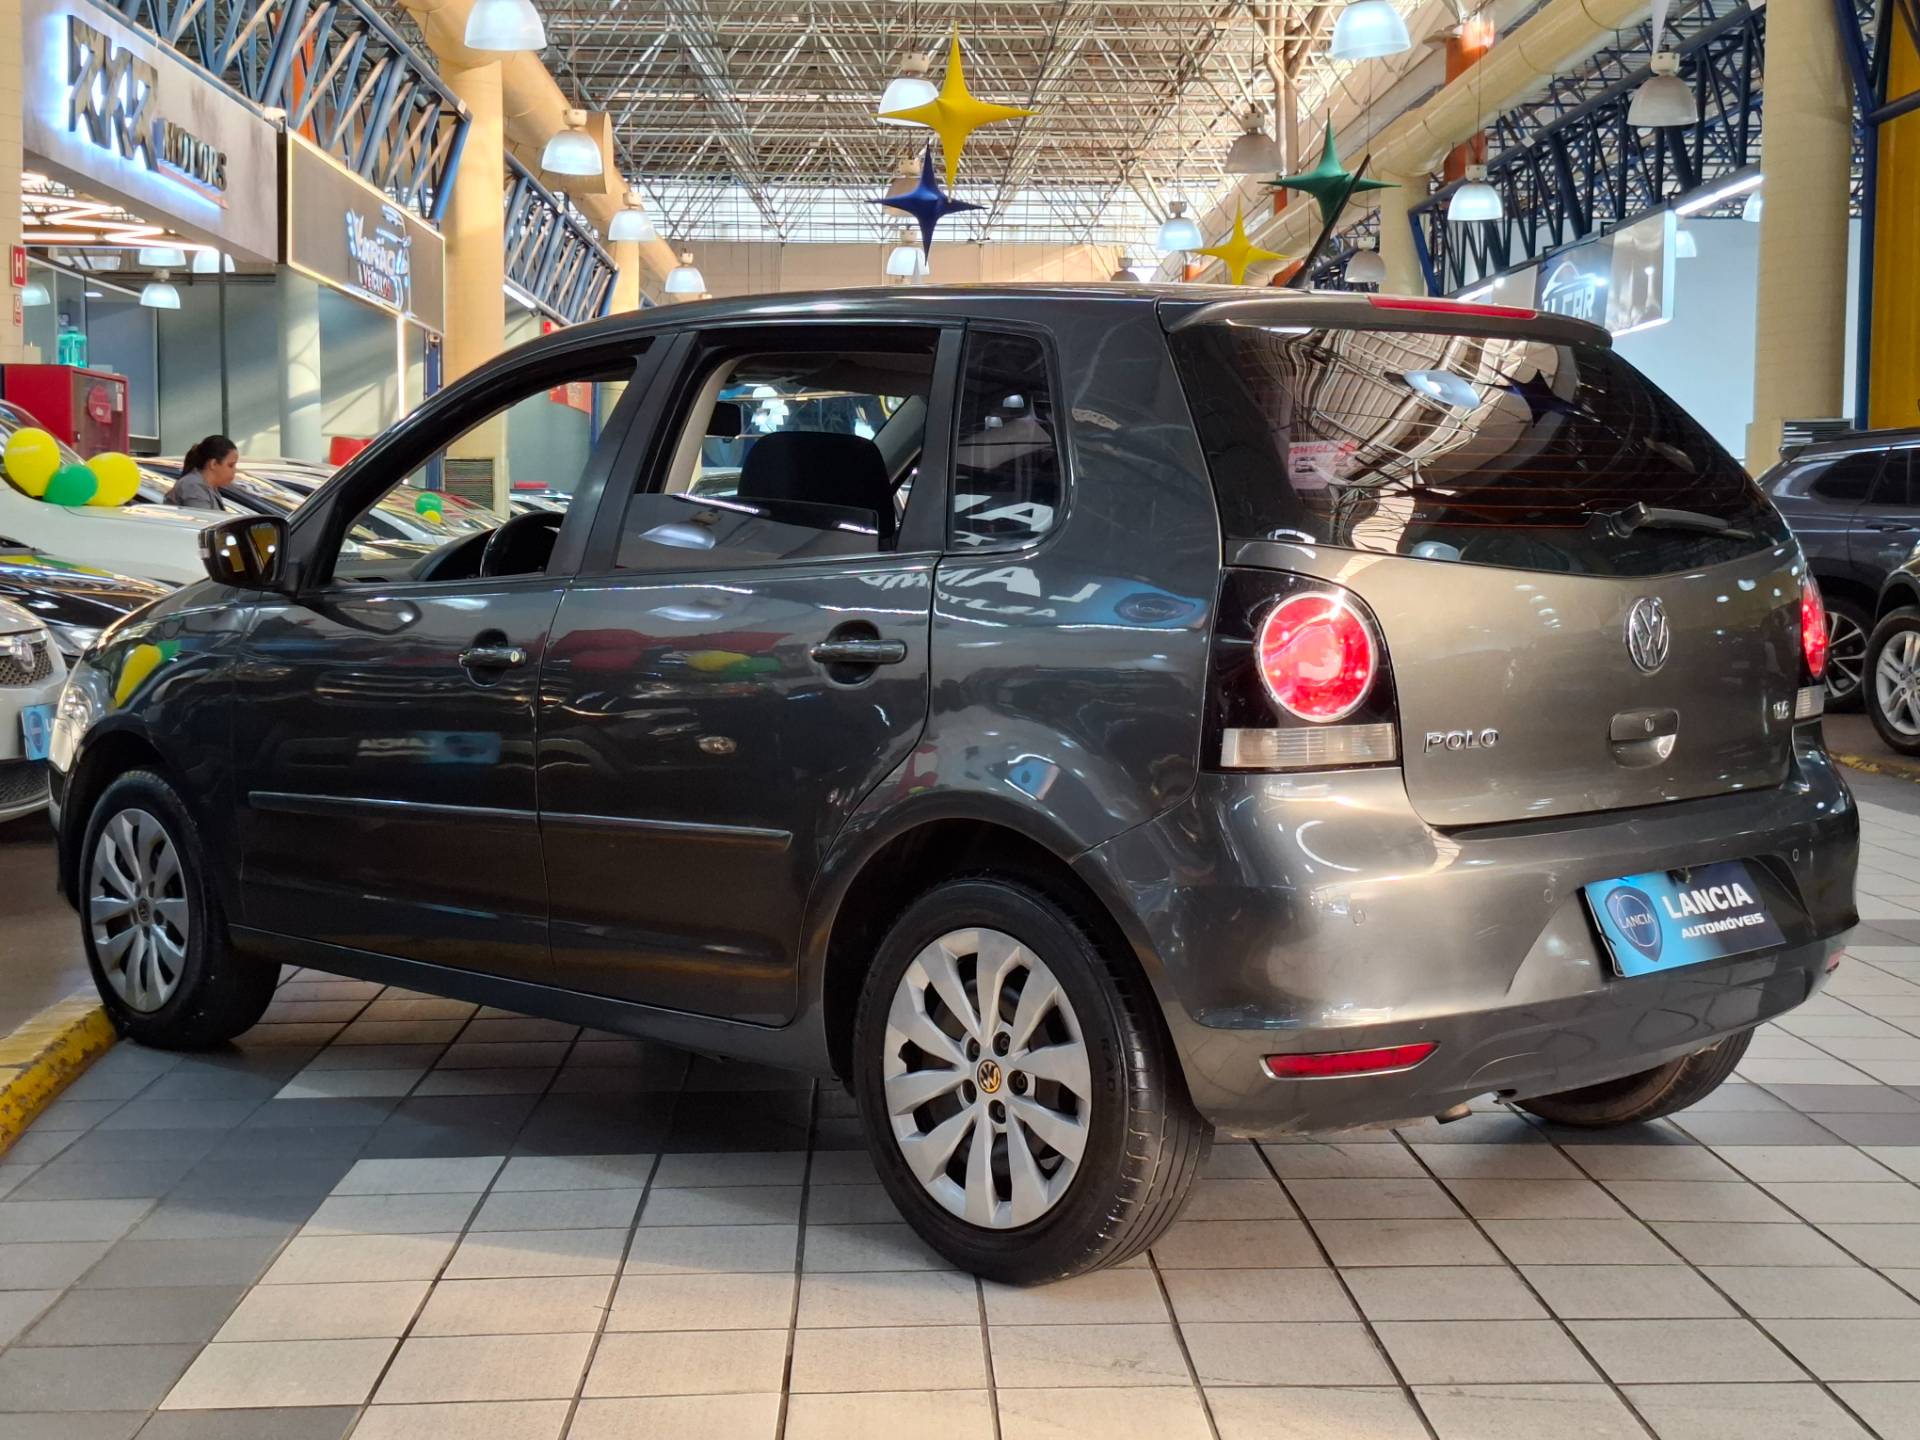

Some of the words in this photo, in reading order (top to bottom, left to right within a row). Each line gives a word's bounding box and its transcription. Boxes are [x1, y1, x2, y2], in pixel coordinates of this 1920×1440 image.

[155, 117, 228, 192] MOTORS
[1423, 728, 1499, 753] POLO
[1661, 882, 1754, 919] LANCIA
[1621, 913, 1655, 930] LANCIA
[1681, 912, 1766, 939] AUTOMÓVEIS
